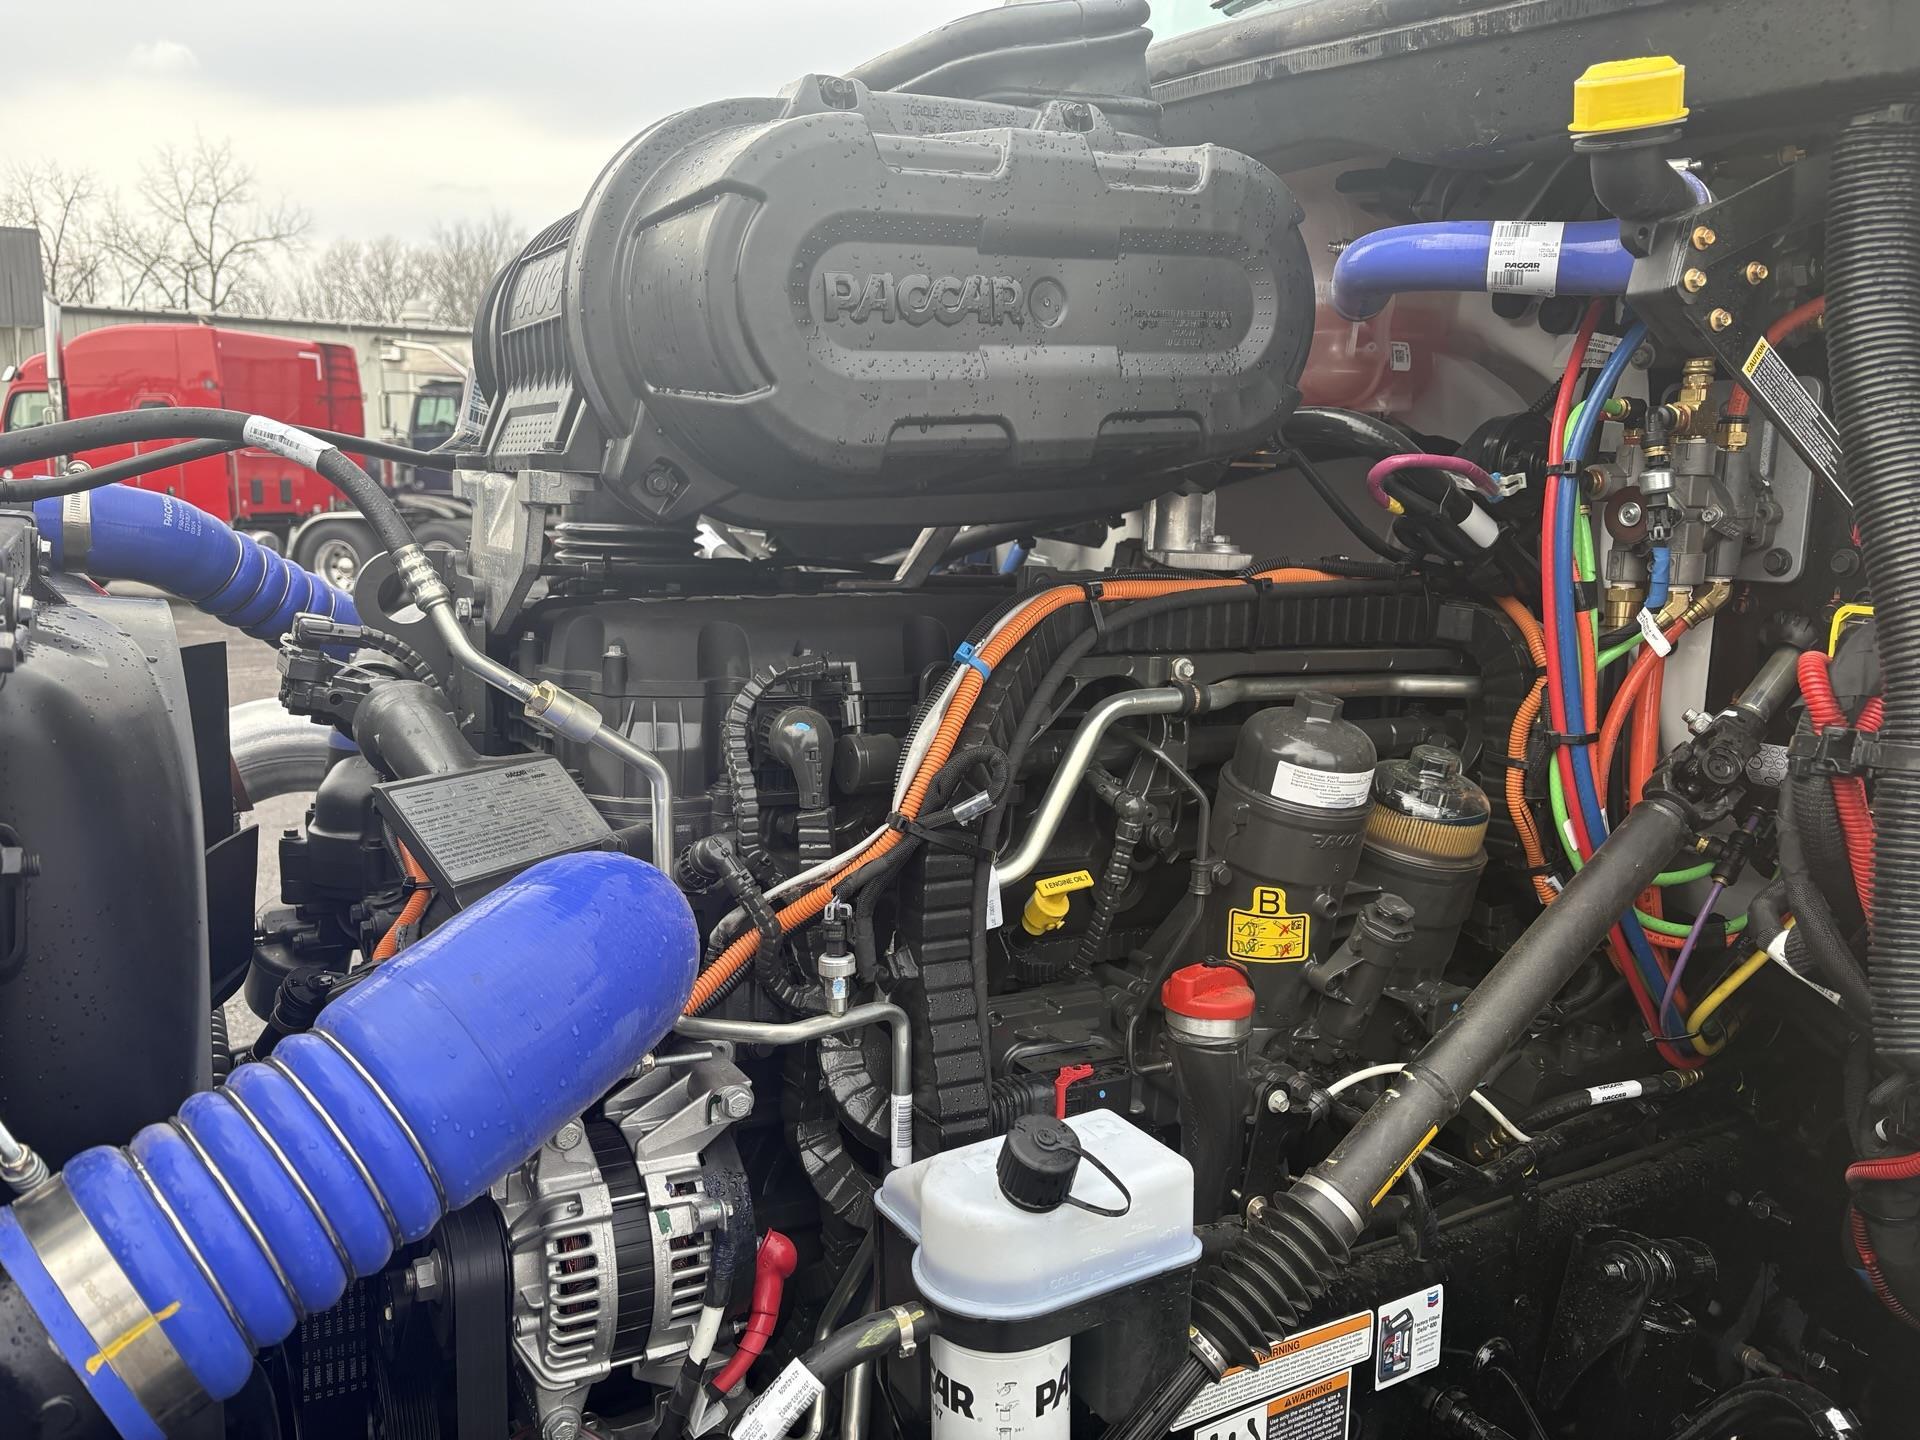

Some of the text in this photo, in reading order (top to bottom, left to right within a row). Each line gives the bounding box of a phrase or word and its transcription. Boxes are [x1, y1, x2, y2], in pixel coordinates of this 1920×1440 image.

[511, 262, 564, 322] PACC
[823, 271, 1025, 328] PACCAR
[1746, 342, 1766, 374] CAUTION
[1766, 350, 1783, 372] Extended
[1048, 875, 1084, 889] ENGINE OIL
[1259, 889, 1280, 915] B
[1400, 1148, 1420, 1173] CAUTION
[1292, 1382, 1333, 1404] WARNING
